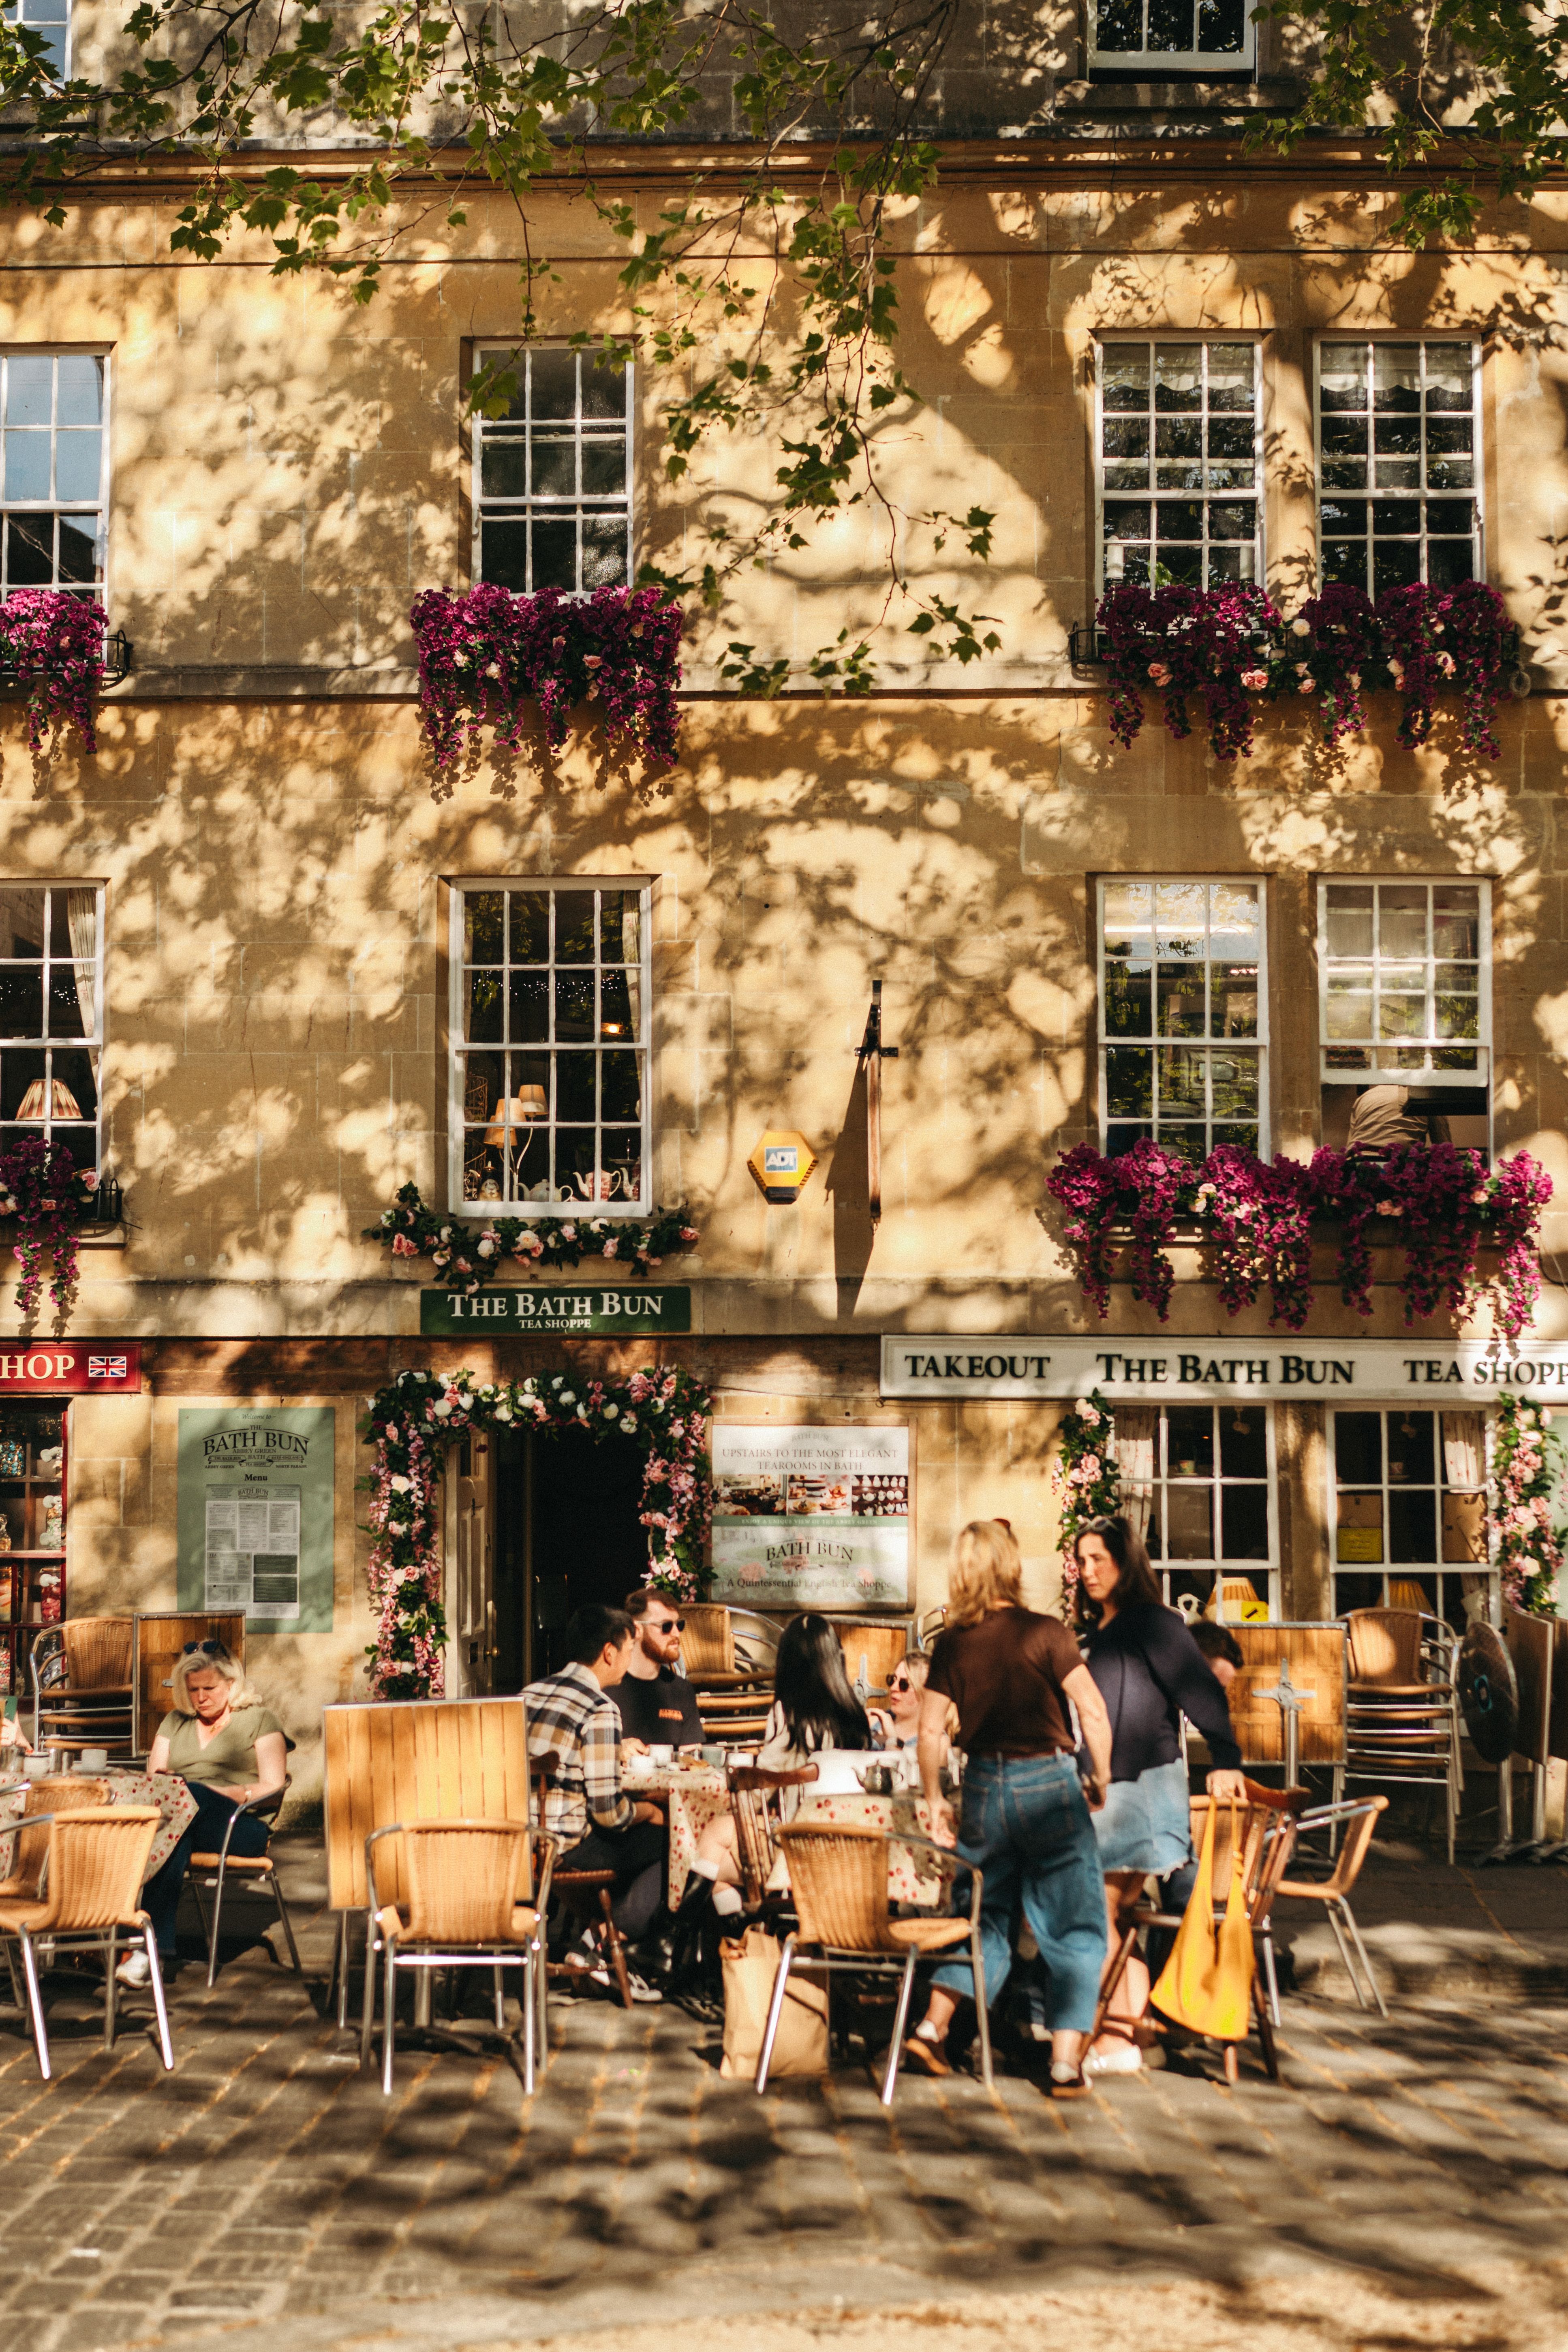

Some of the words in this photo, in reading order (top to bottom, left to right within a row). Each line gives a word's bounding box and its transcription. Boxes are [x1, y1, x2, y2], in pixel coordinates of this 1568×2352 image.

[767, 1151, 796, 1166] ADT
[447, 1294, 508, 1317] THE
[515, 1293, 593, 1316] BATH
[600, 1292, 663, 1316] BUN
[519, 1320, 542, 1329] TEA
[545, 1319, 591, 1329] SHOPPE
[904, 1355, 1051, 1378] TAKEOUT
[1095, 1353, 1168, 1383] THE
[1176, 1354, 1270, 1384] BATH
[1279, 1355, 1355, 1384] BUN
[1403, 1359, 1465, 1383] TEA
[203, 1432, 257, 1457] BATH
[265, 1432, 309, 1455] BUN
[722, 1449, 772, 1457] UPSTAIRS
[774, 1449, 789, 1457] TO
[793, 1449, 813, 1457] THE
[817, 1449, 846, 1458] MOST
[758, 1461, 817, 1470] TEAROOMS
[820, 1462, 831, 1470] IN
[834, 1462, 862, 1470] BATH
[244, 1473, 268, 1481] Menu
[238, 1488, 254, 1496] BATH
[766, 1542, 810, 1561] BATH
[817, 1542, 853, 1561] BUN
[727, 1578, 734, 1587] A
[737, 1578, 801, 1588] Quintessential
[859, 1579, 892, 1590] Shoppe
